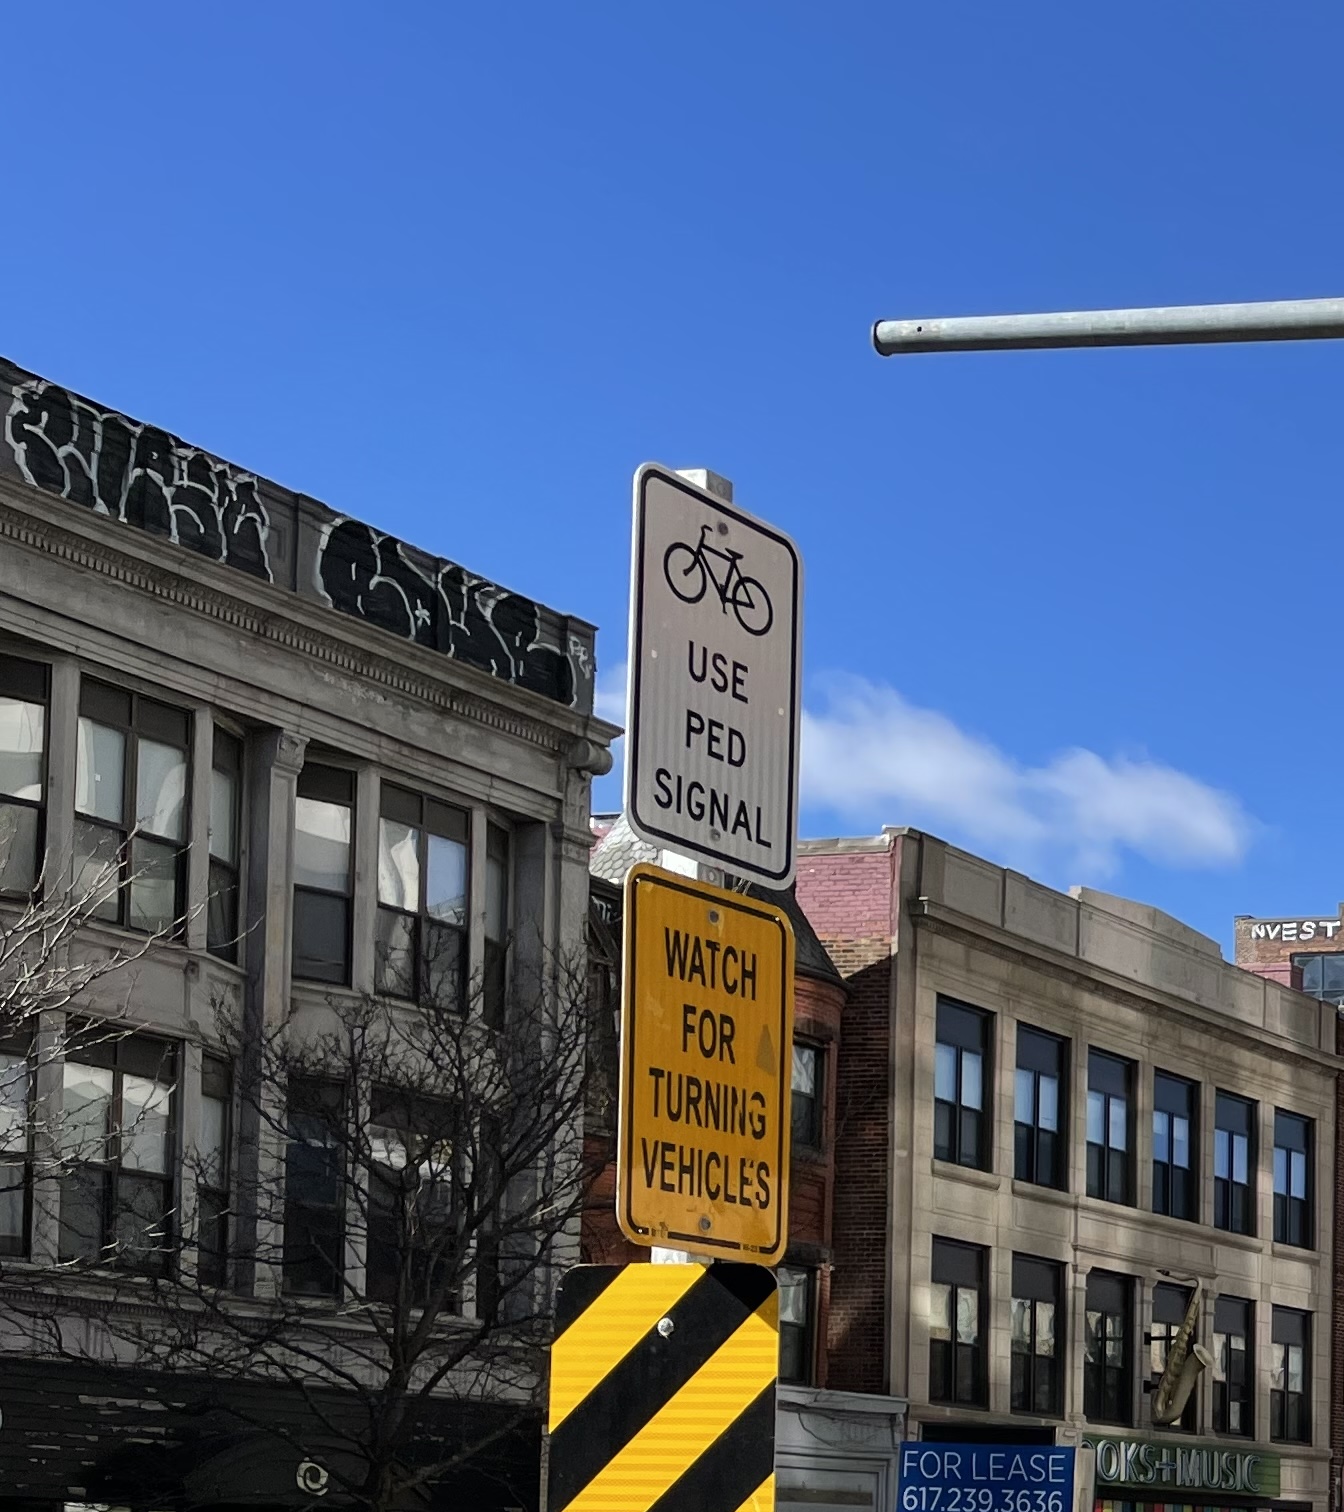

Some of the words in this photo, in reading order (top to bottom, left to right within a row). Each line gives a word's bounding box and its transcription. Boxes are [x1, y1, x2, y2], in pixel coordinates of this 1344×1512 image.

[688, 640, 749, 704] USE
[685, 709, 747, 768] PED
[653, 767, 772, 849] SIGNAL
[664, 926, 757, 1001] WATCH
[681, 1004, 736, 1065] FOR
[648, 1067, 767, 1141] TURNING
[640, 1137, 771, 1210] VEHICLES
[902, 1450, 962, 1480] FOR
[972, 1452, 1067, 1483] LEASE
[1081, 1439, 1261, 1493] OKS+MUSIC
